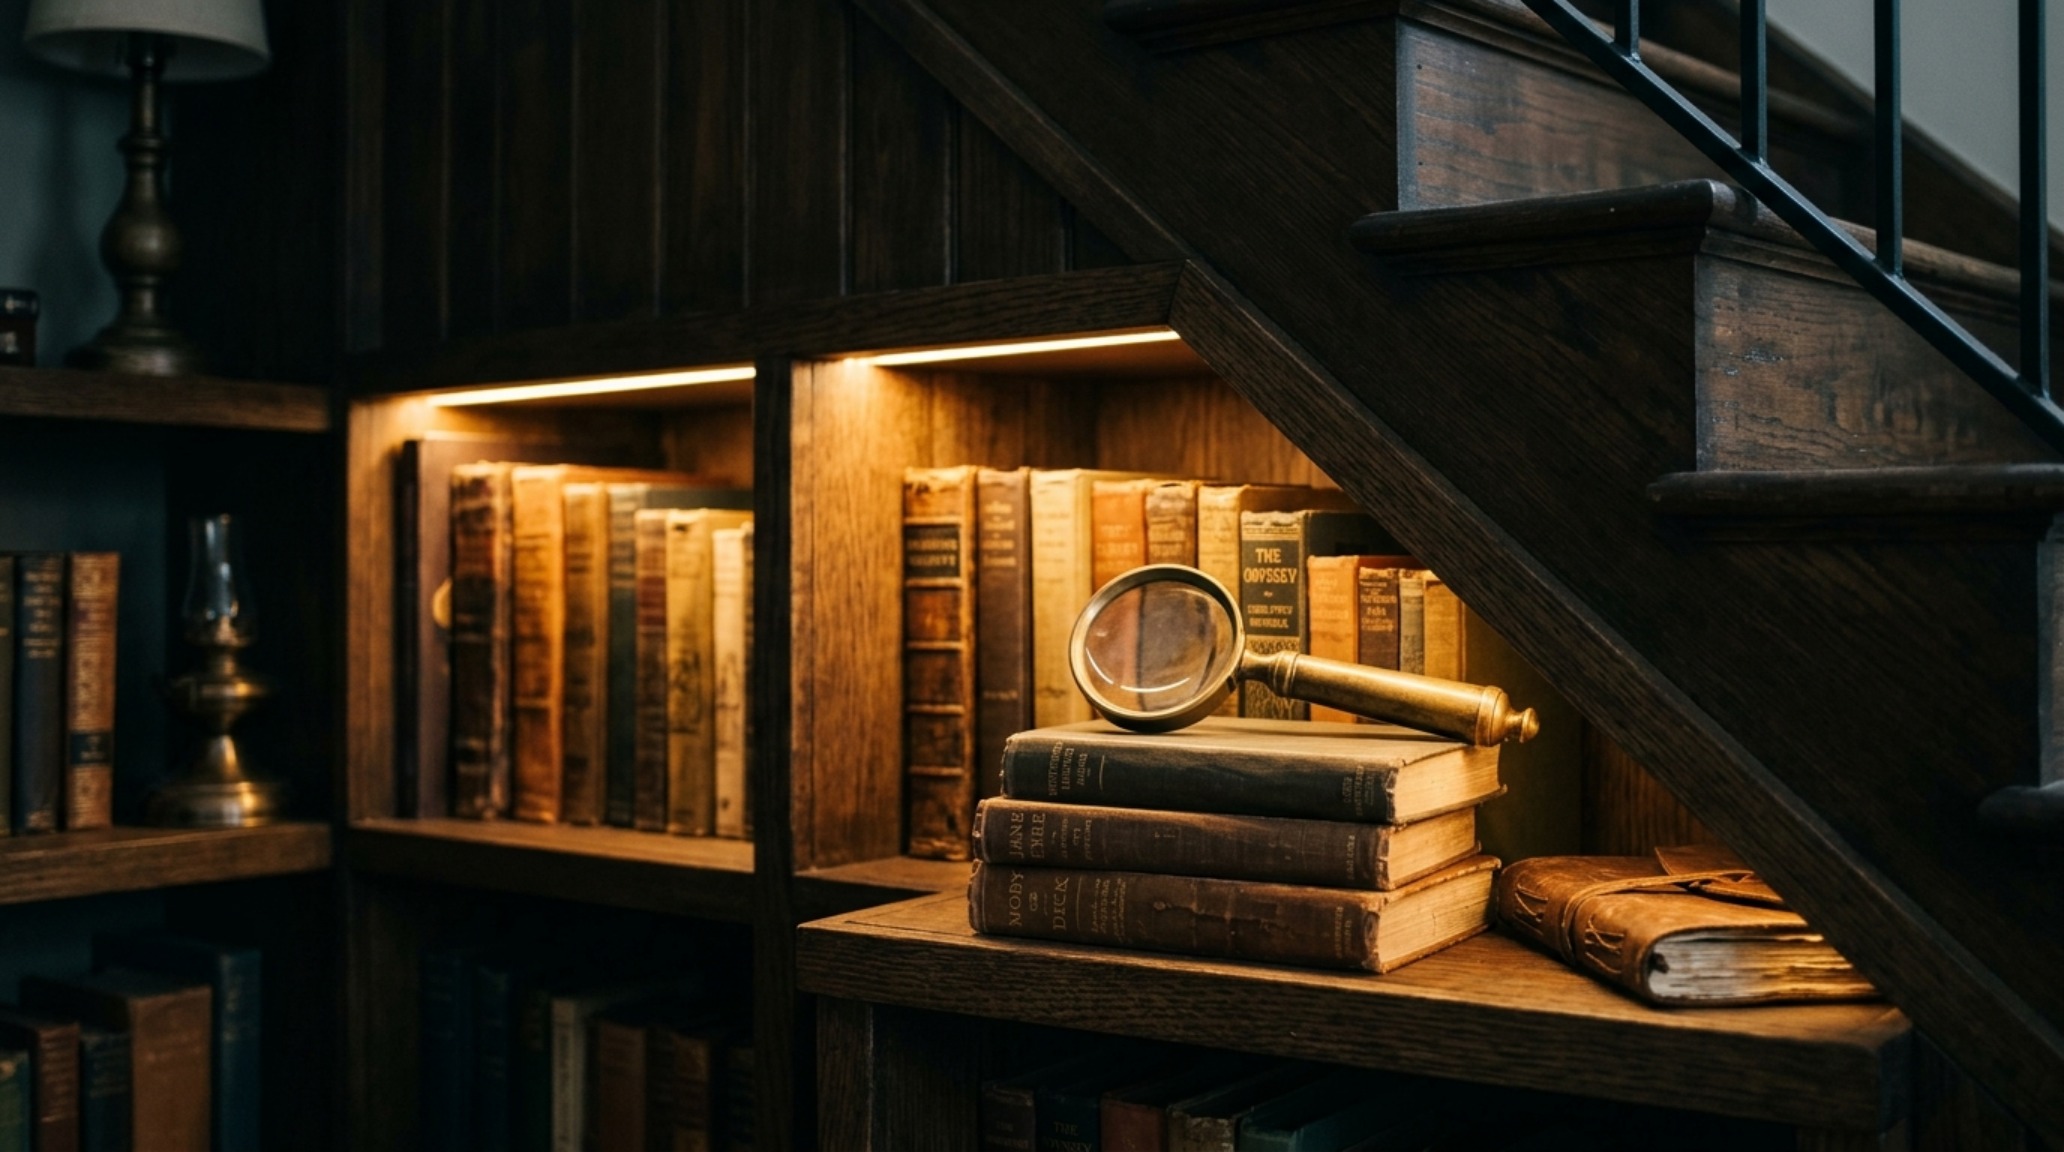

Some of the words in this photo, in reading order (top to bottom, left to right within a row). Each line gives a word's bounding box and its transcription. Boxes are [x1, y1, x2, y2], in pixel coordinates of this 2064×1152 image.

[1243, 567, 1297, 583] ODYSSEY
[1255, 548, 1281, 563] THE
[1008, 812, 1025, 859] JANE
[1008, 870, 1024, 927] MOBY
[1052, 876, 1069, 931] DICK
